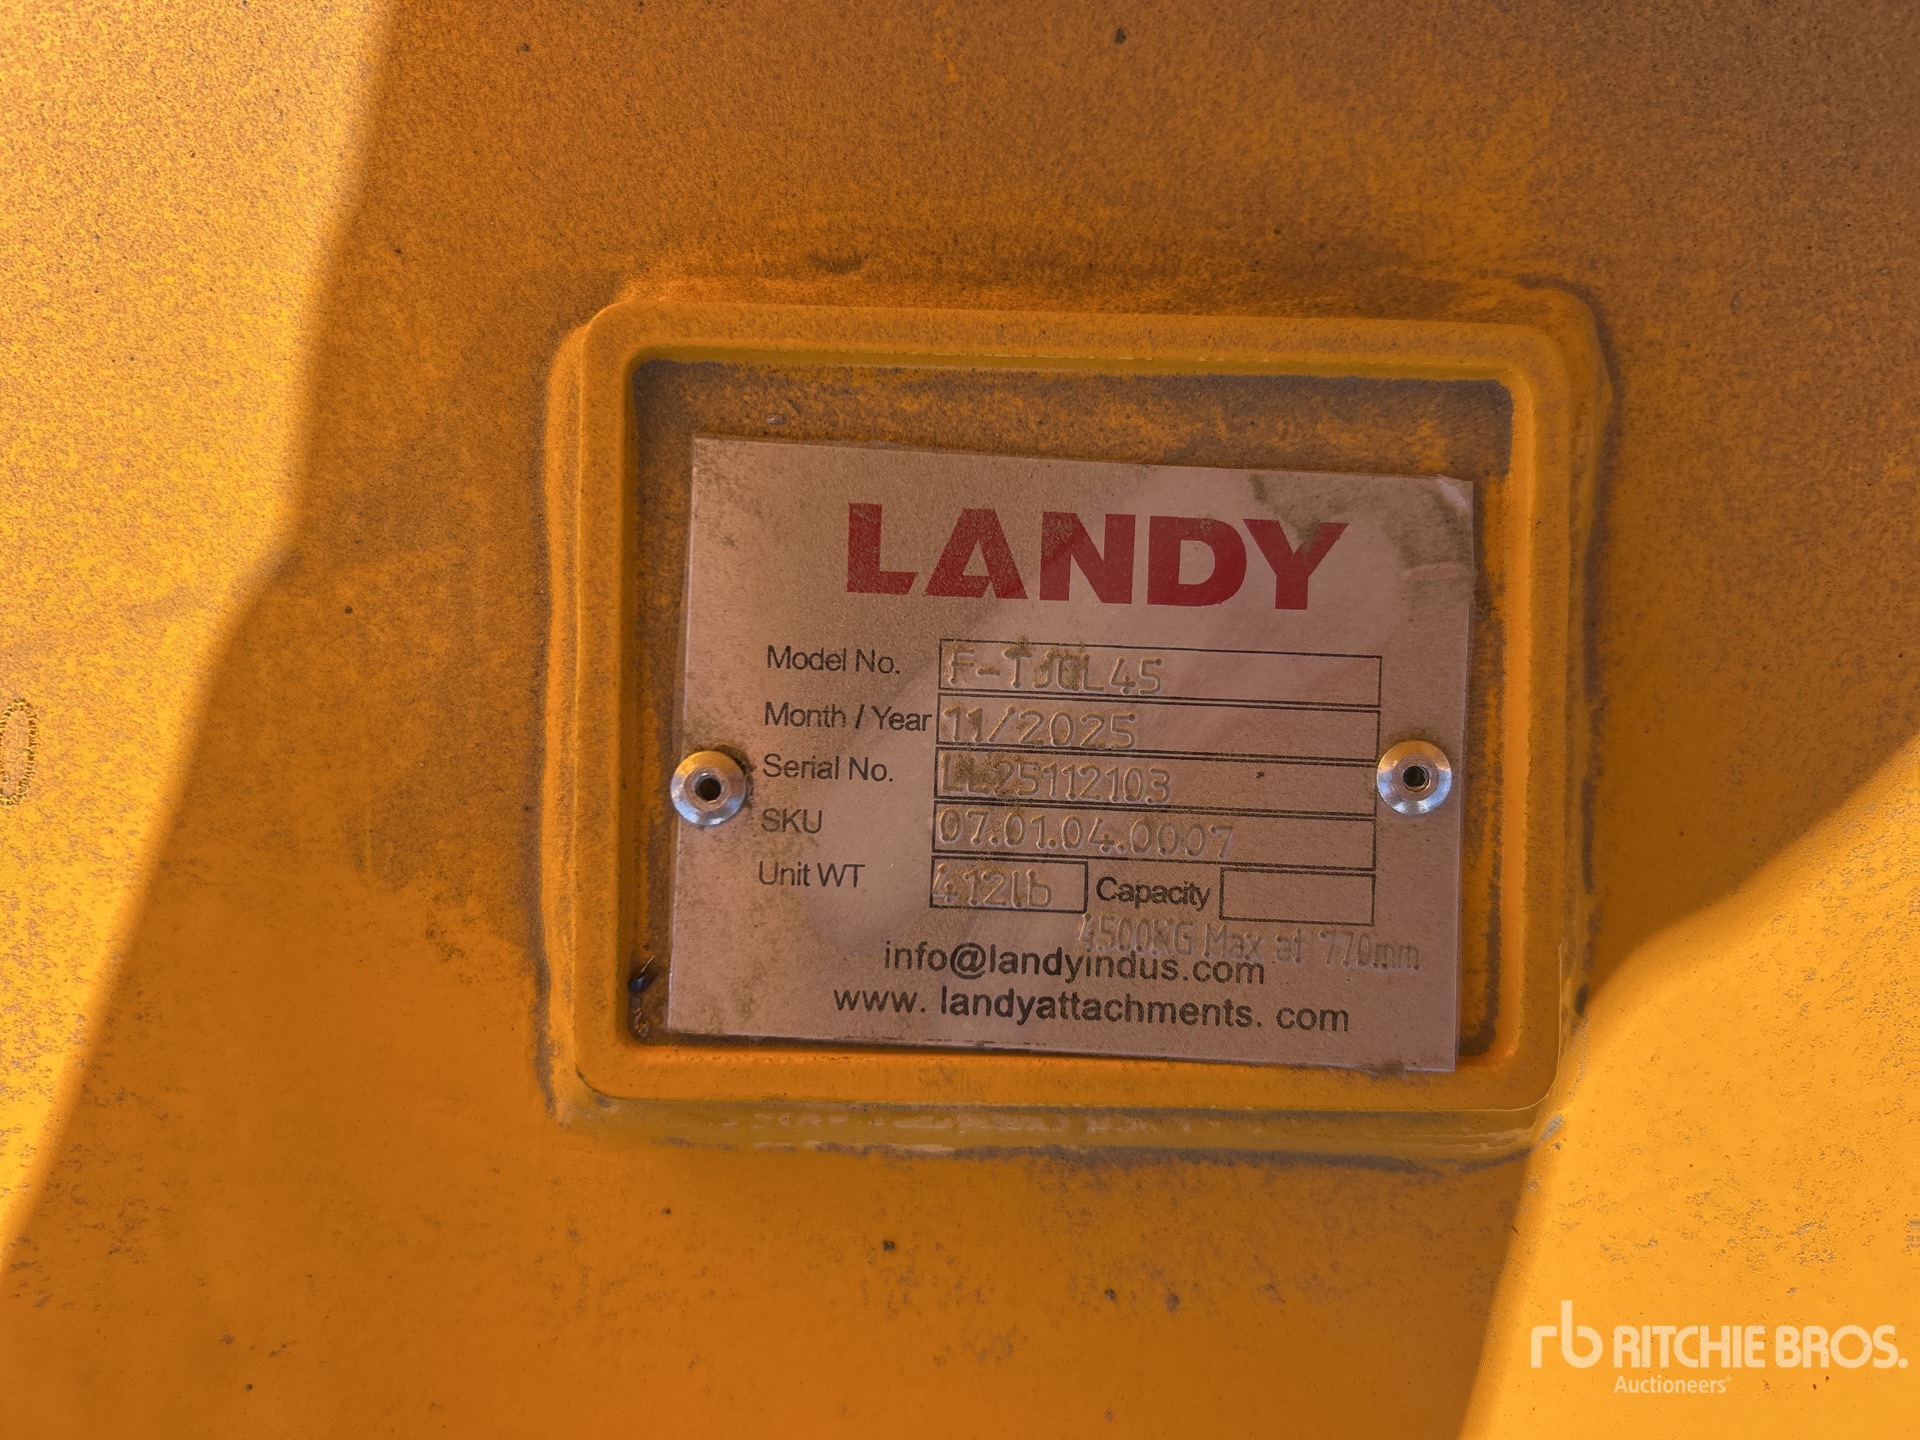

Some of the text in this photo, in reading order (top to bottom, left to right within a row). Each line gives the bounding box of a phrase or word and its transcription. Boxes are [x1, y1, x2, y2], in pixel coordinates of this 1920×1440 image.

[846, 502, 1350, 611] LANDY
[766, 645, 847, 672] Model
[855, 649, 901, 674] No.
[764, 702, 1136, 749] Month / Year 11/2025
[762, 754, 840, 780] Serial
[848, 757, 895, 782] No.
[760, 808, 1234, 859] SKU 07.01.04.0007
[758, 862, 811, 886] Unit
[816, 864, 866, 888] WT
[1096, 876, 1211, 911] Capacity
[884, 940, 1265, 984] info@landyindus.com
[1203, 923, 1262, 962] Max
[1274, 930, 1305, 964] at
[1319, 931, 1420, 972] 770mm
[833, 986, 1350, 1032] www. landyattachments. com
